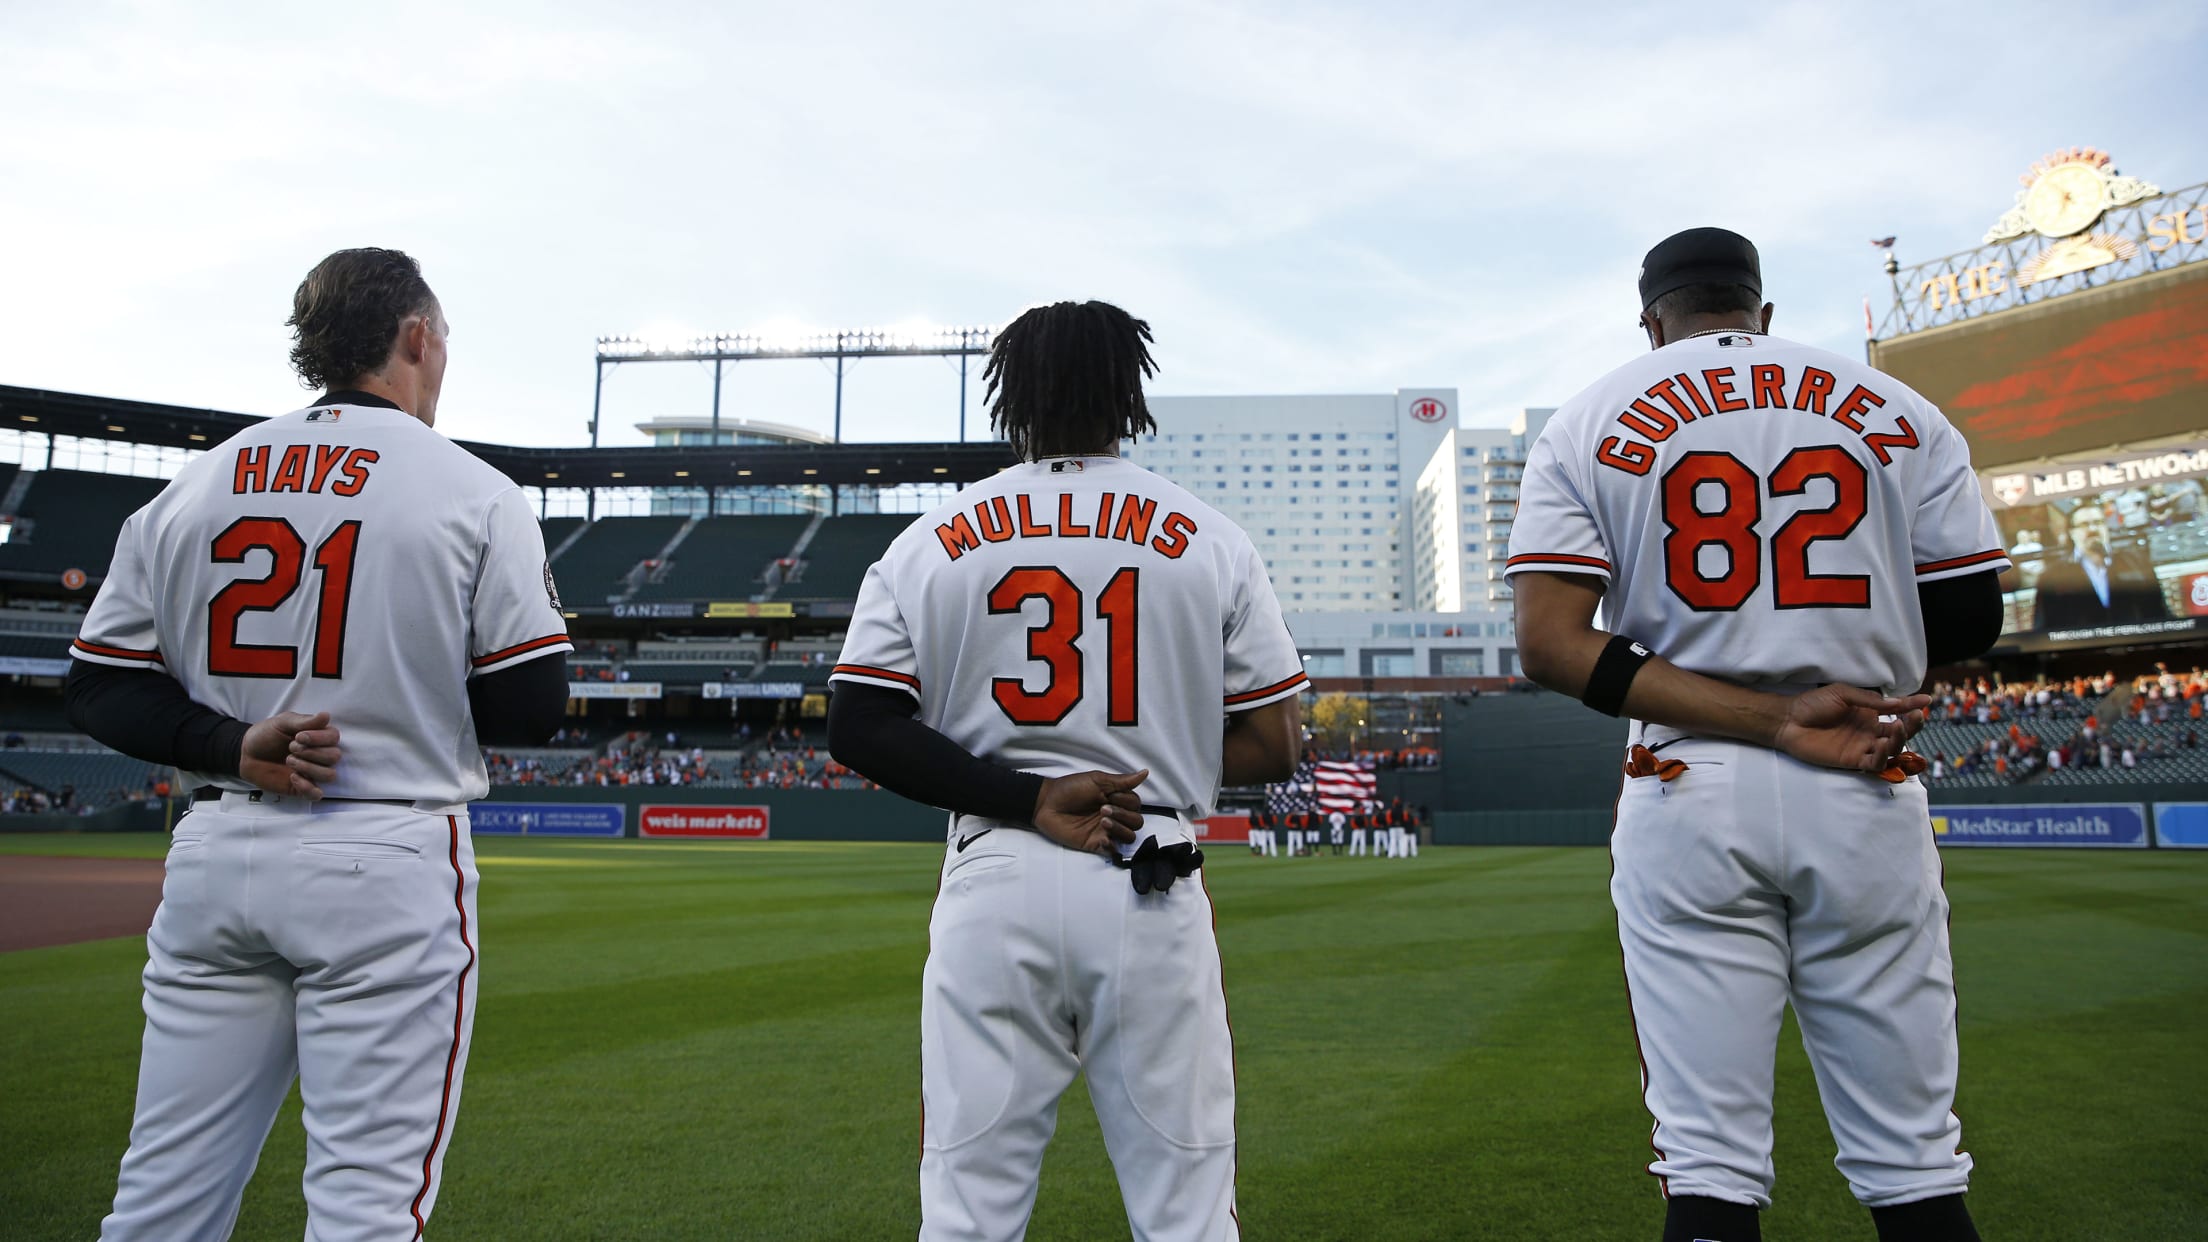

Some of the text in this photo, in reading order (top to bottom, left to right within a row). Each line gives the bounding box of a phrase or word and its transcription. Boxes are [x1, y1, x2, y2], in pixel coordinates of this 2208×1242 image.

[1921, 261, 2008, 310] THE
[1596, 364, 1920, 476] GUTIERREZ
[233, 444, 380, 497] HAYS
[2033, 470, 2087, 496] MLB
[934, 492, 1198, 561] MULLINS
[1661, 444, 1872, 612] 82
[208, 516, 362, 680] 21
[614, 604, 660, 617] GANZ
[987, 566, 1139, 727] 31
[761, 684, 801, 697] UNION
[647, 813, 763, 830] weis markets
[1951, 816, 2111, 836] MedStar Health
